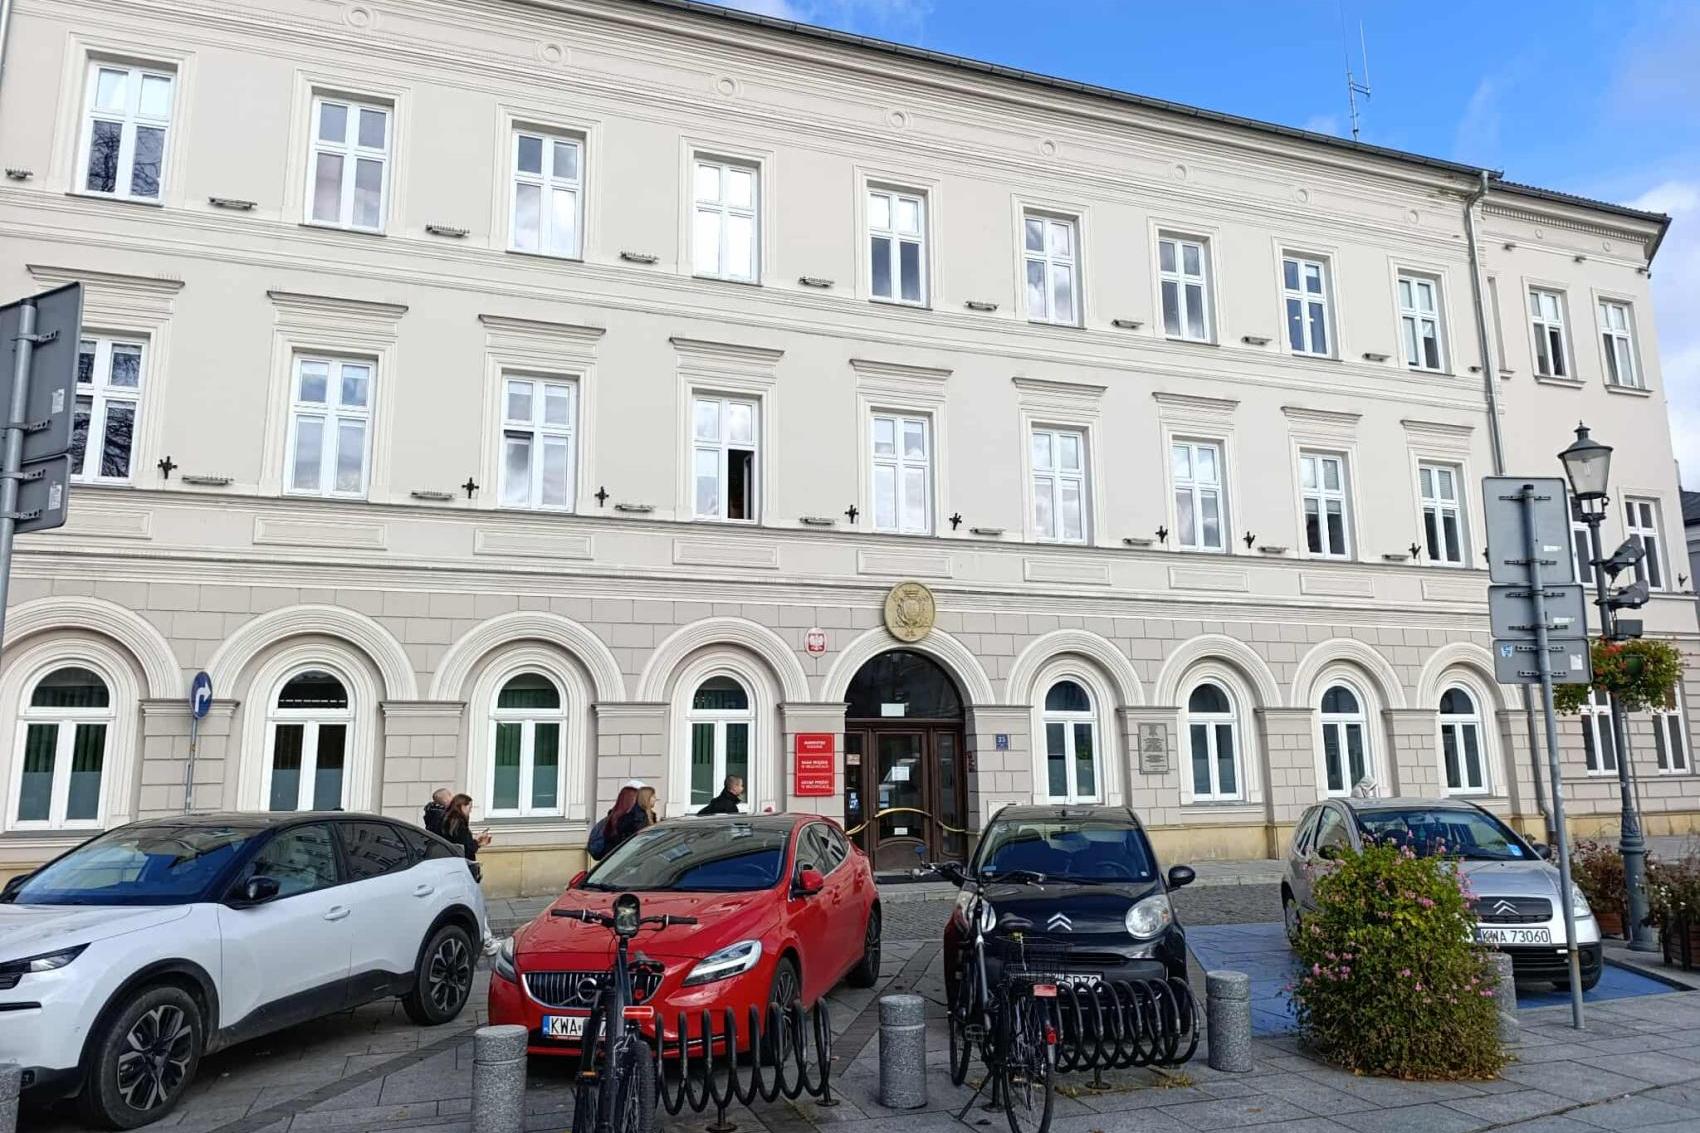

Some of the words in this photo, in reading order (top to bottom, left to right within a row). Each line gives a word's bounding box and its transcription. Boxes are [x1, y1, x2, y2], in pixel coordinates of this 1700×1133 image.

[1482, 930, 1507, 942] KWA
[1510, 930, 1549, 943] 73060
[551, 1018, 578, 1035] KWA
